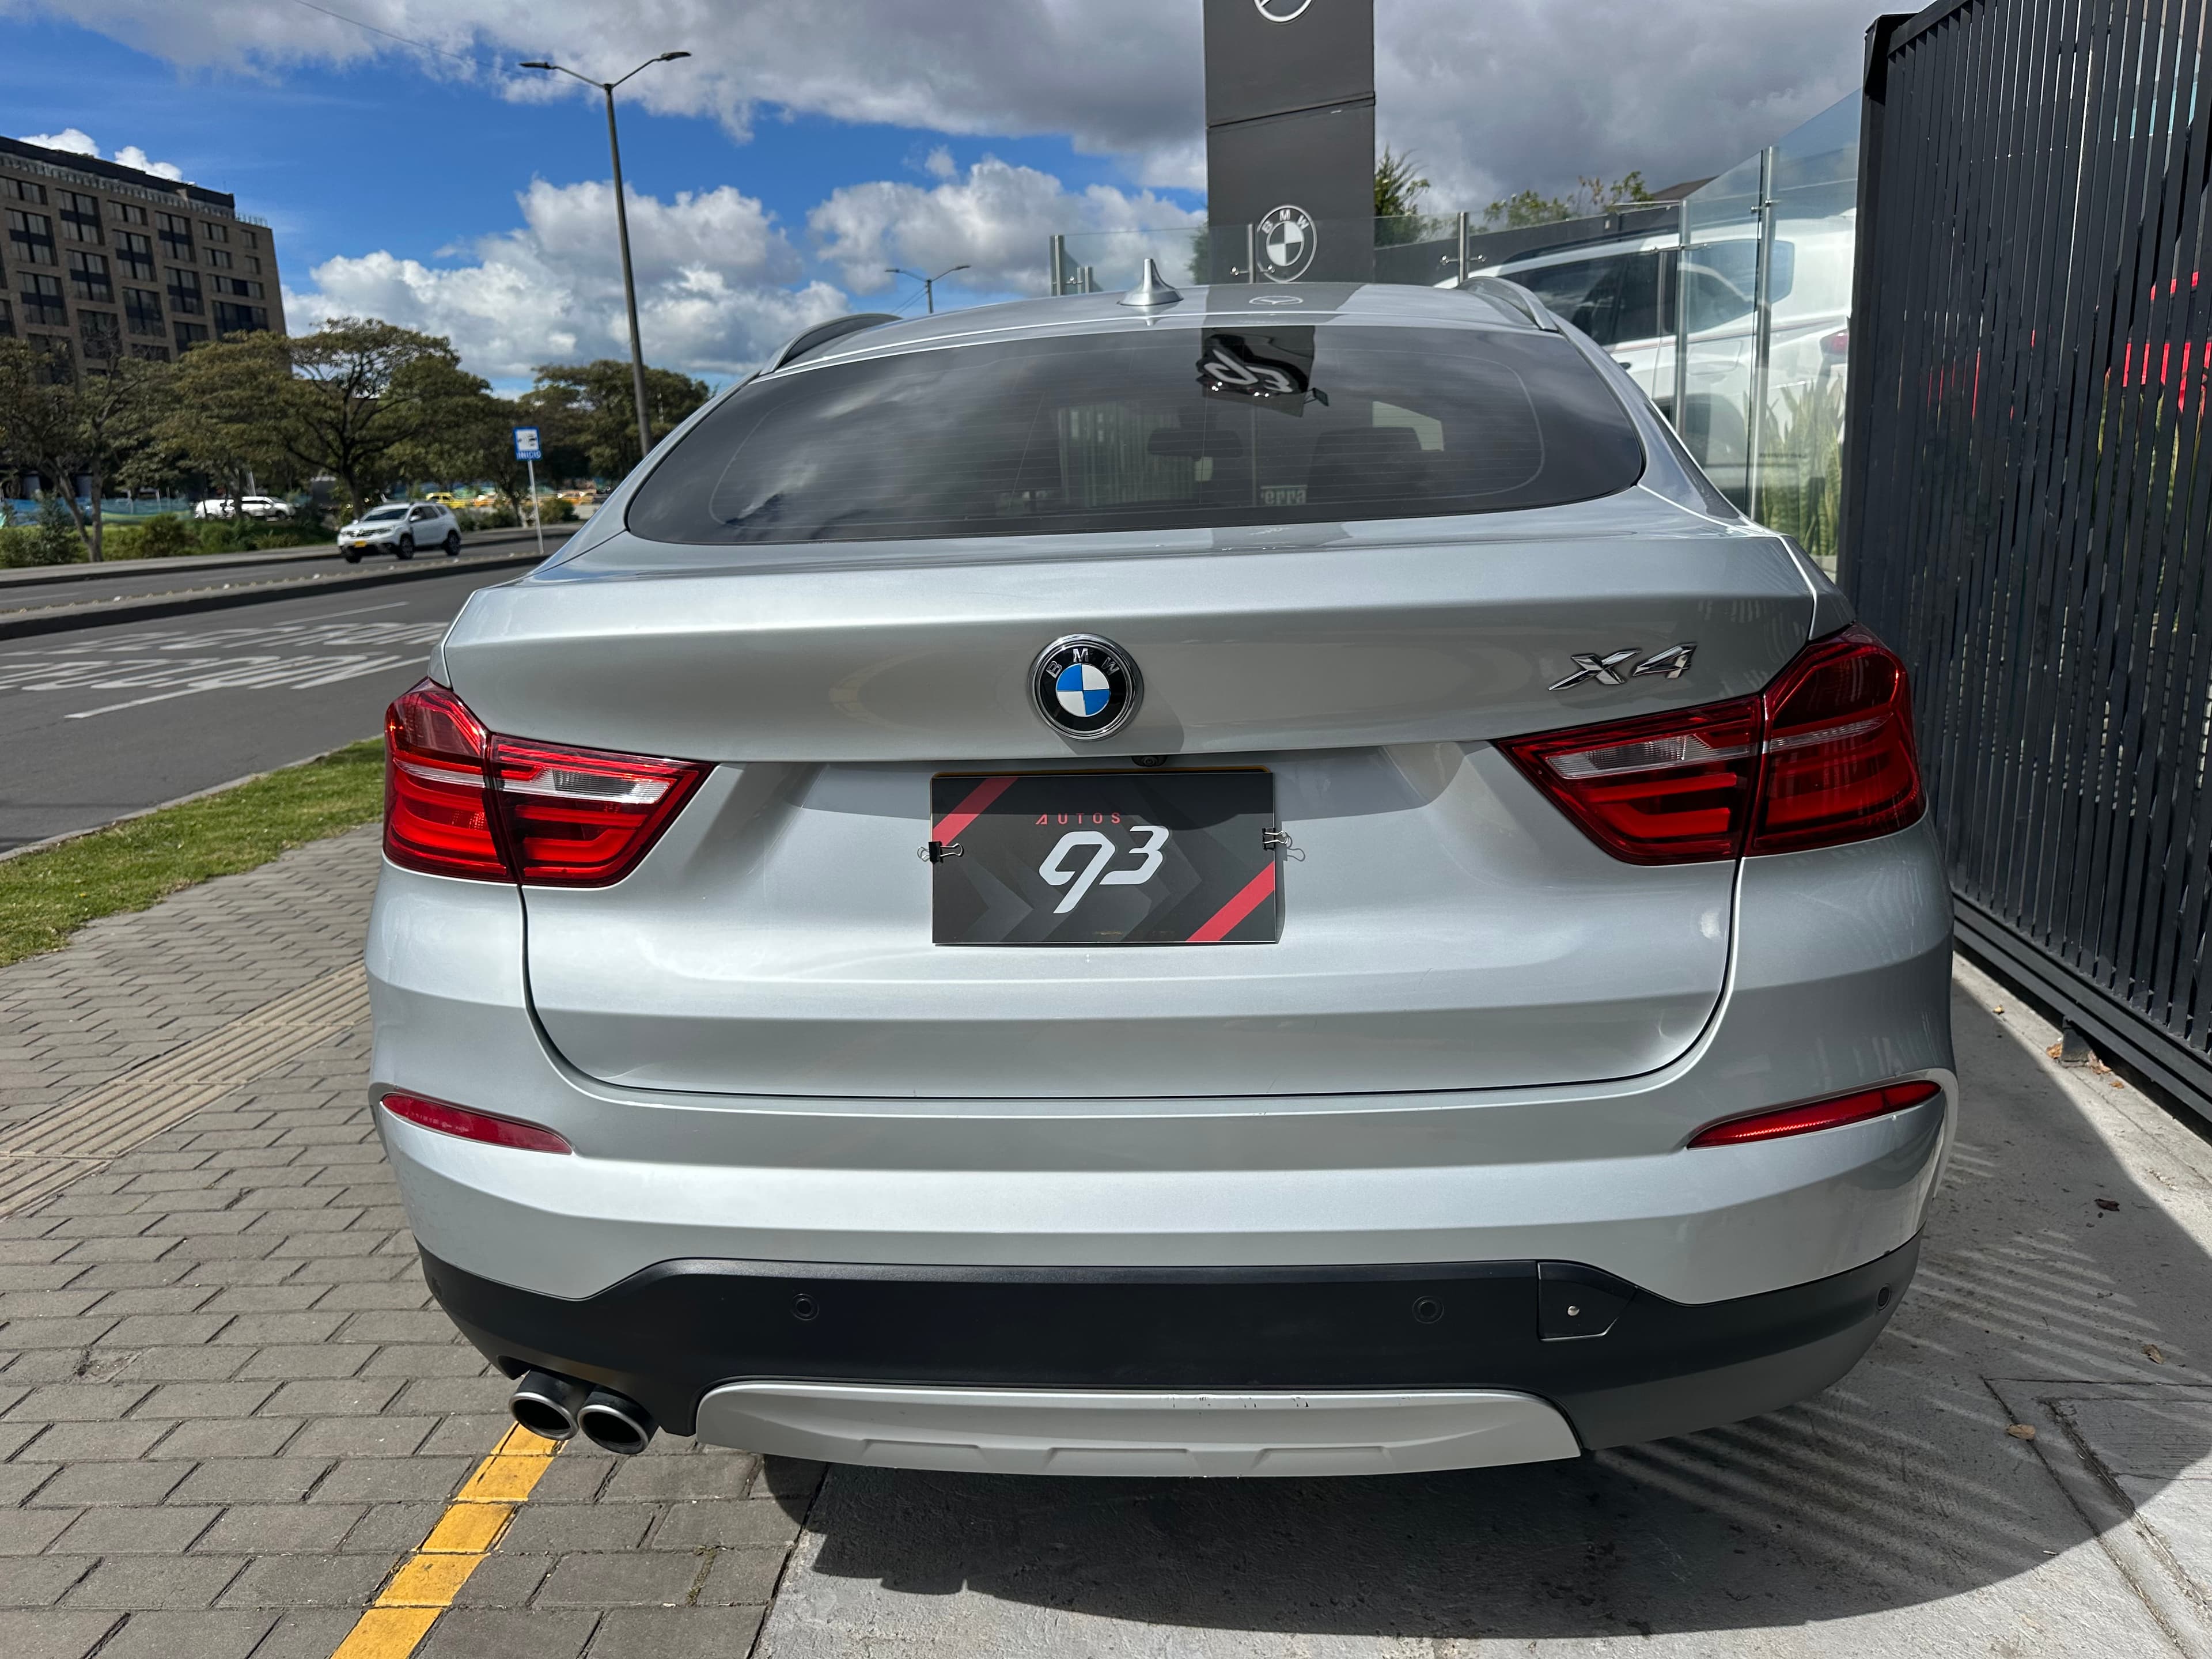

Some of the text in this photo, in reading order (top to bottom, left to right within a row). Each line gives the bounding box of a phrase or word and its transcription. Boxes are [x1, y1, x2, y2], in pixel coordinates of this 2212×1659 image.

[1262, 209, 1310, 234] BMW
[517, 450, 541, 460] INICIO
[0, 652, 431, 691] TECCIÓN
[1046, 647, 1120, 679] BMW
[1547, 641, 1698, 691] X4
[1035, 813, 1121, 825] AUTOS
[1039, 825, 1169, 914] 93
